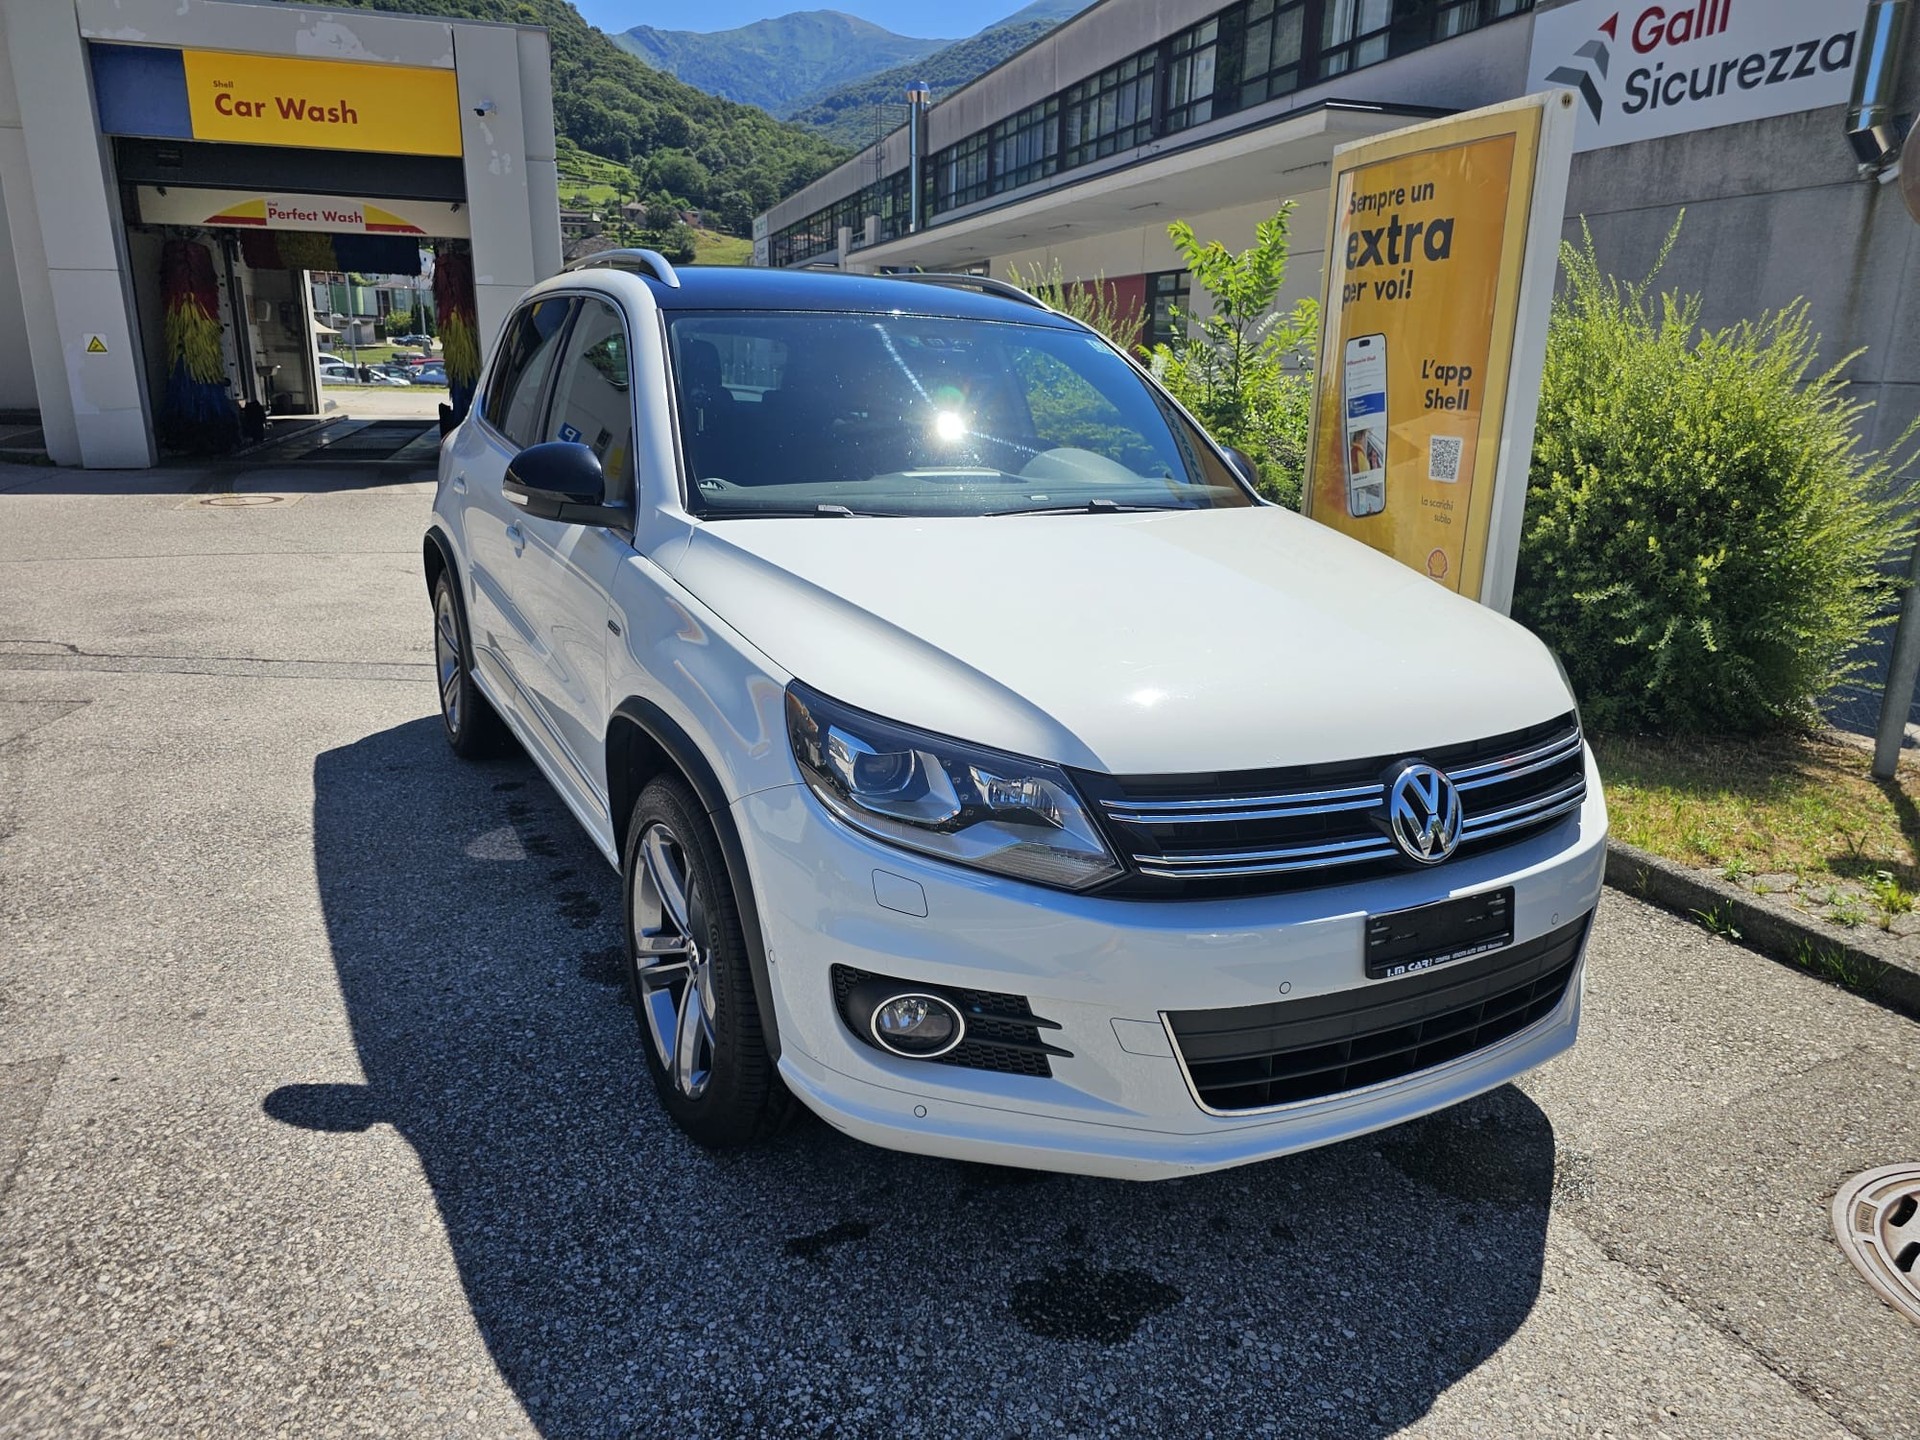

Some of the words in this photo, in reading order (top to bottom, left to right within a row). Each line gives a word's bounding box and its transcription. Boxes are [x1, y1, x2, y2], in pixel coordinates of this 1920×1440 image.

[213, 80, 234, 88] Shell
[1622, 29, 1857, 115] Sicurezza
[215, 93, 266, 118] Car
[274, 97, 358, 124] Wash
[268, 207, 318, 221] Perfect
[322, 210, 363, 223] Wash
[1349, 187, 1405, 216] Sempre
[1411, 182, 1435, 203] un
[1345, 213, 1455, 270] extra
[1374, 268, 1414, 301] voi!
[1424, 388, 1470, 411] Shell
